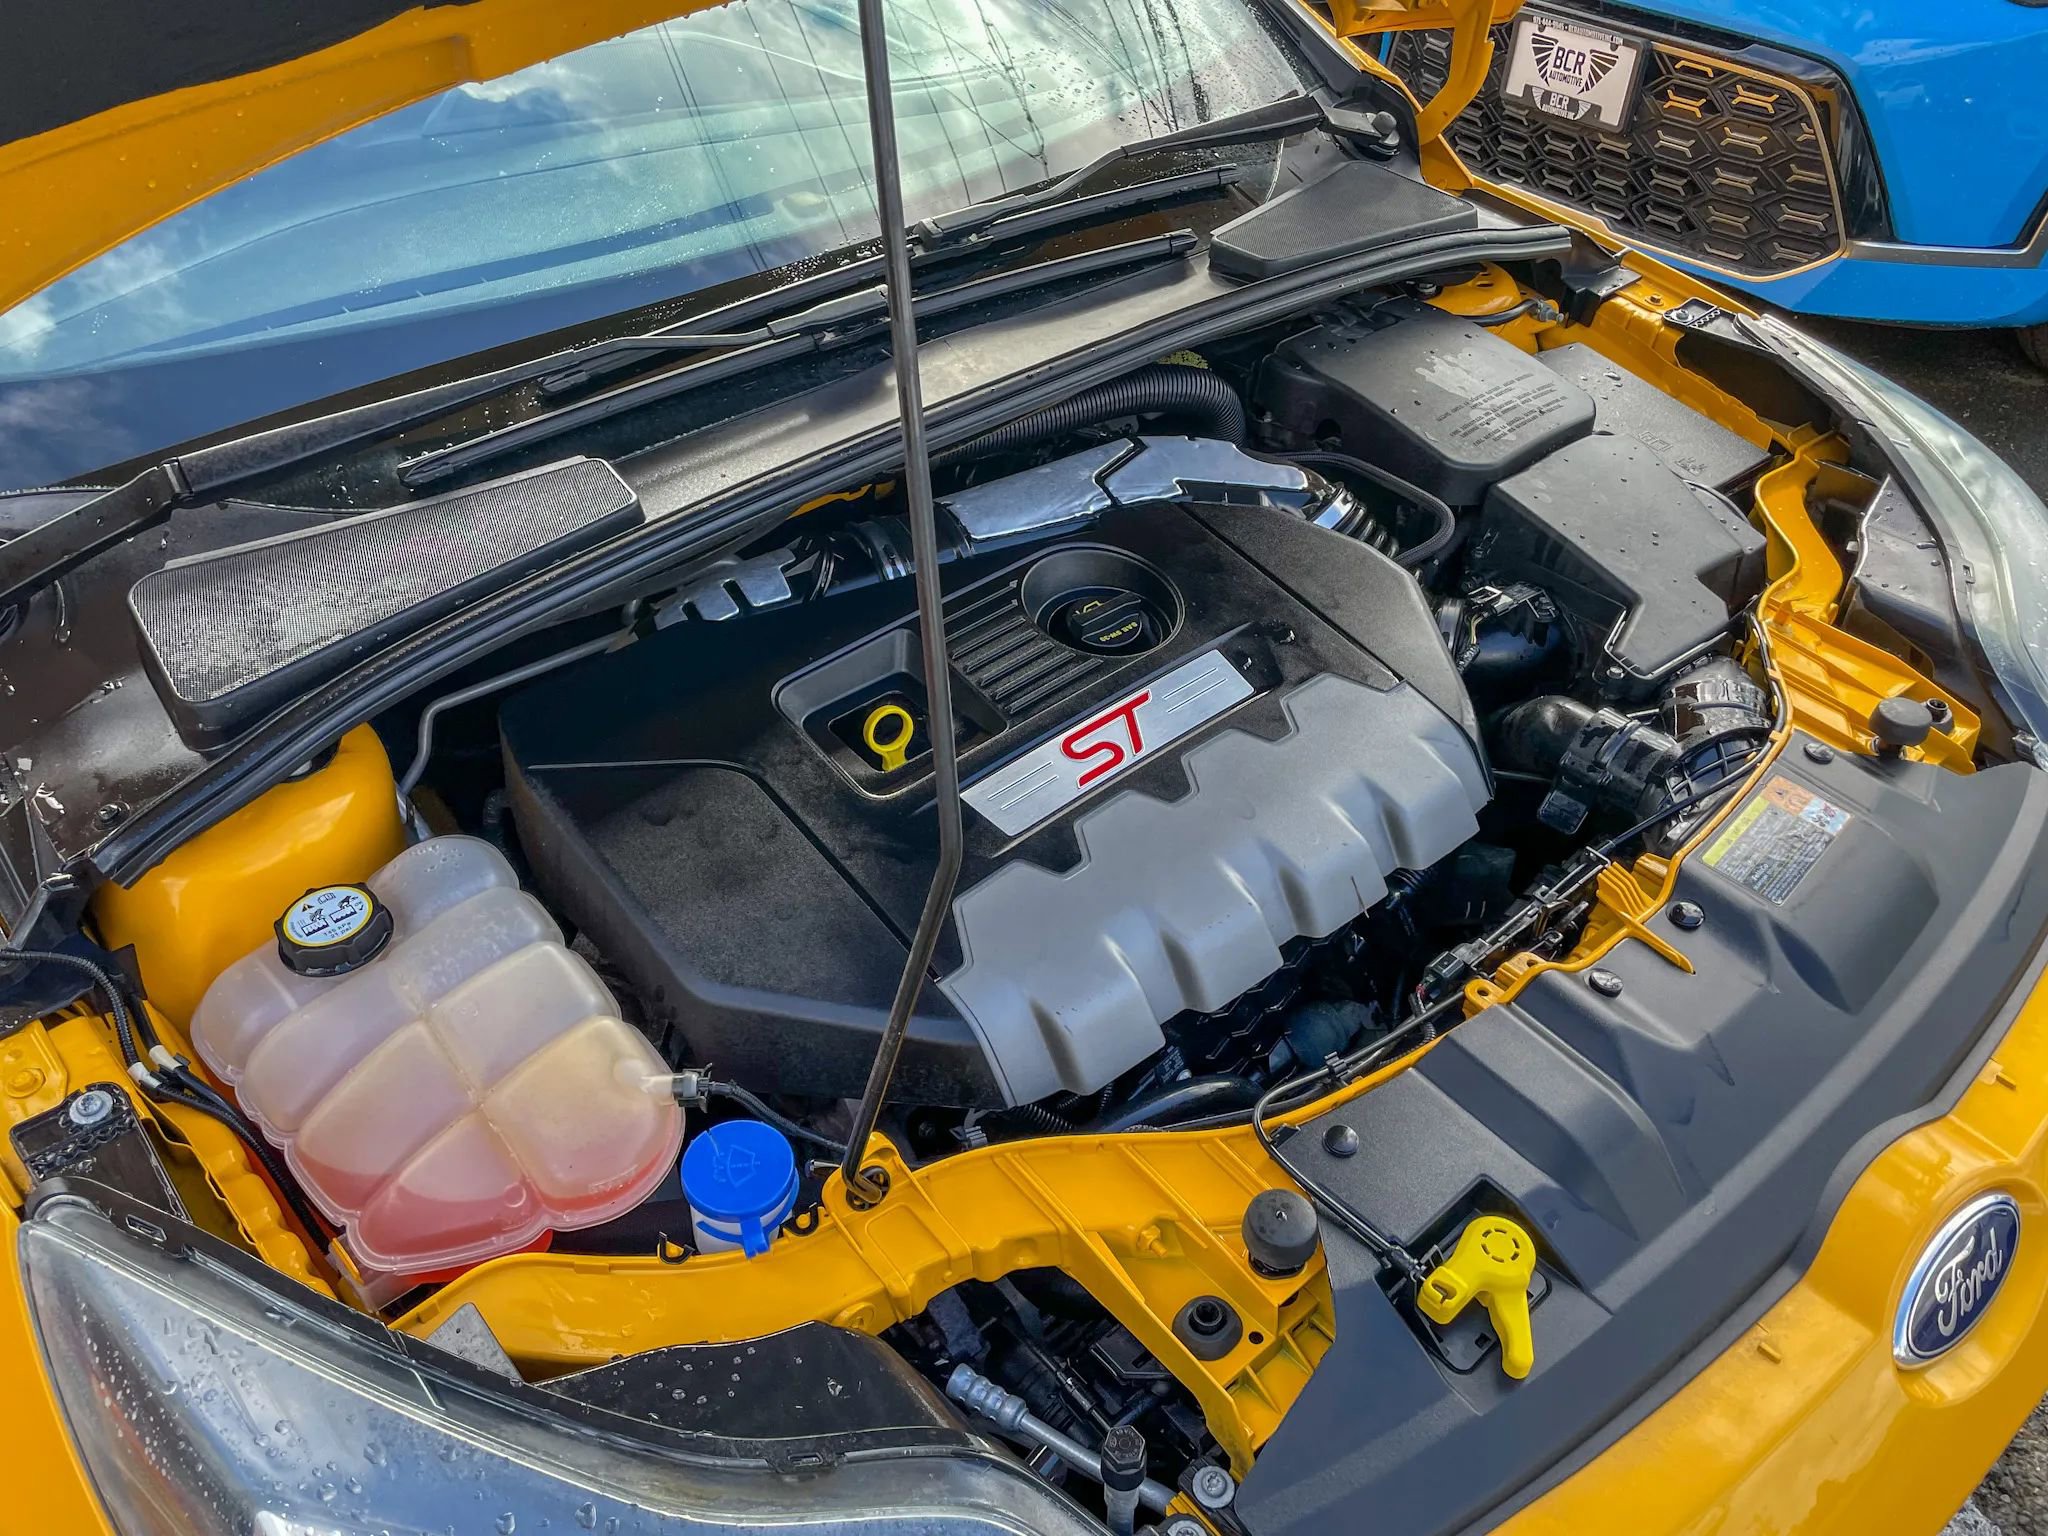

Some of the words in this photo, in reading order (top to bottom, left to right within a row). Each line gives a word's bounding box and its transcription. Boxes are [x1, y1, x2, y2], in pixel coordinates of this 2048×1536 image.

[1553, 46, 1586, 75] BCR
[1549, 70, 1583, 87] AUTOMOTIVE
[1550, 92, 1569, 110] BCR
[1060, 689, 1152, 789] ST
[1935, 1227, 2003, 1337] Ford
